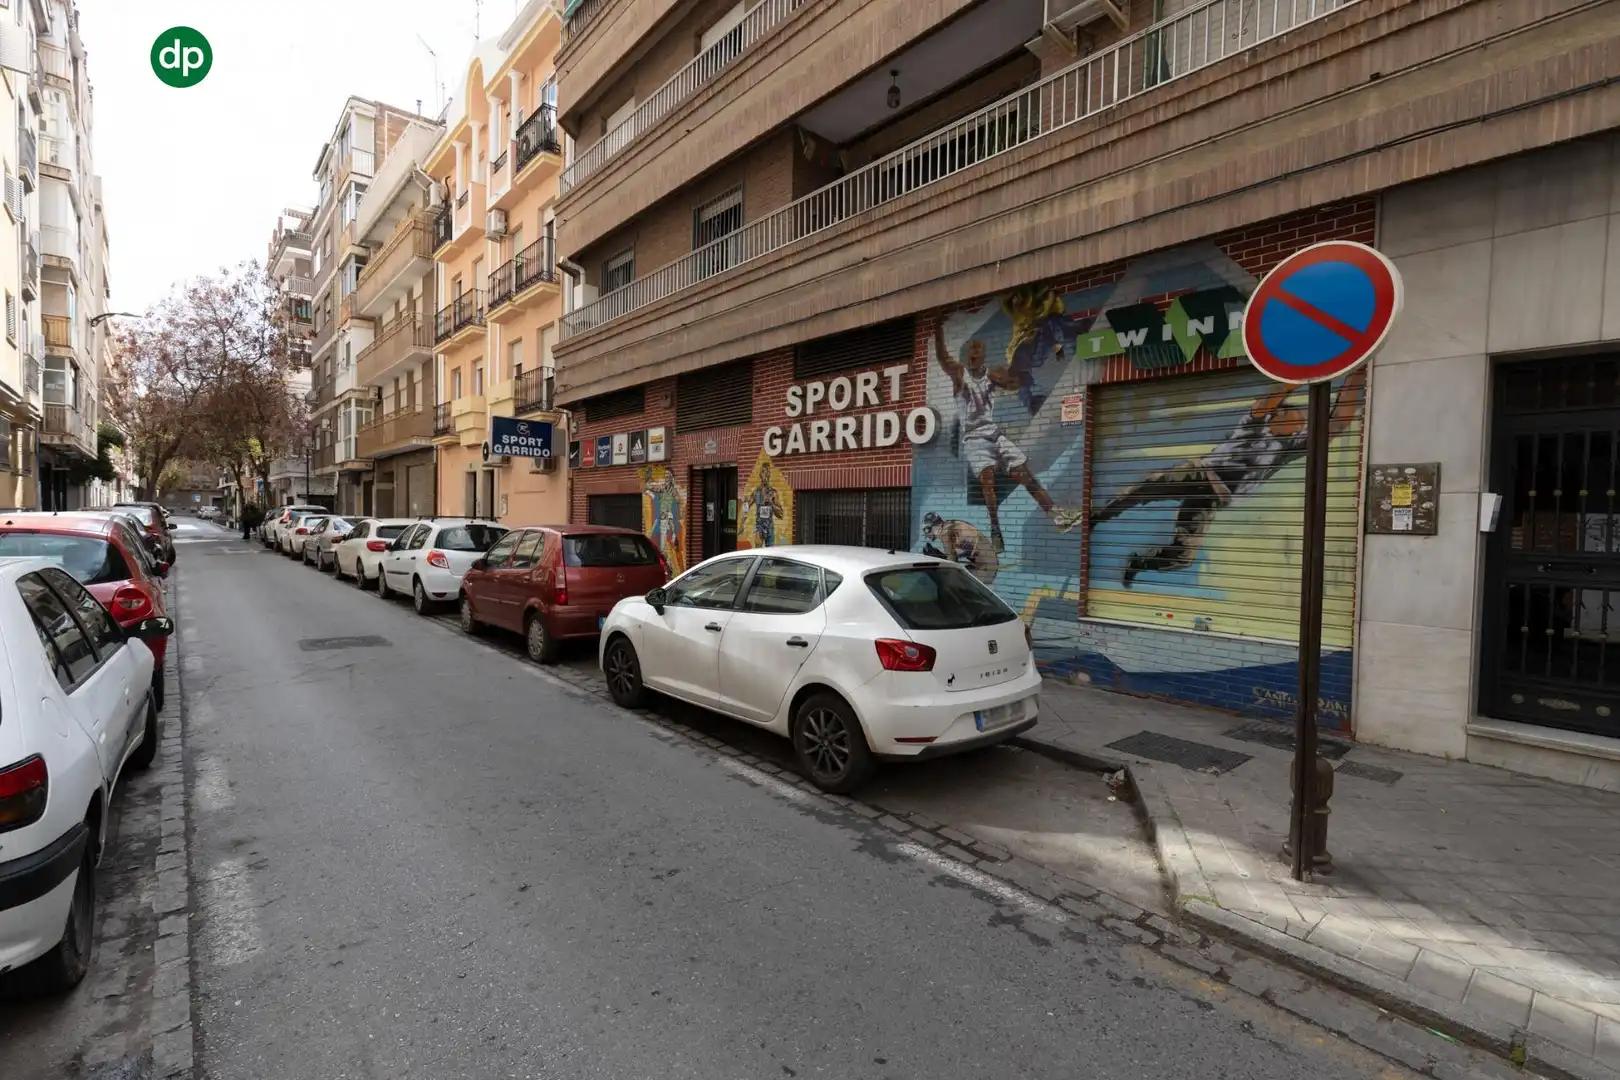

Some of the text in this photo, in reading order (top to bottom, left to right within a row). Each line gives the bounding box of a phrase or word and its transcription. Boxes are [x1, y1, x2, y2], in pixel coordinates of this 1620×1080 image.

[785, 364, 908, 418] SPORT
[763, 407, 937, 457] GARRIDO
[502, 434, 543, 447] SPORT
[493, 443, 551, 457] GARRIDO
[980, 667, 1008, 679] IBIZA
